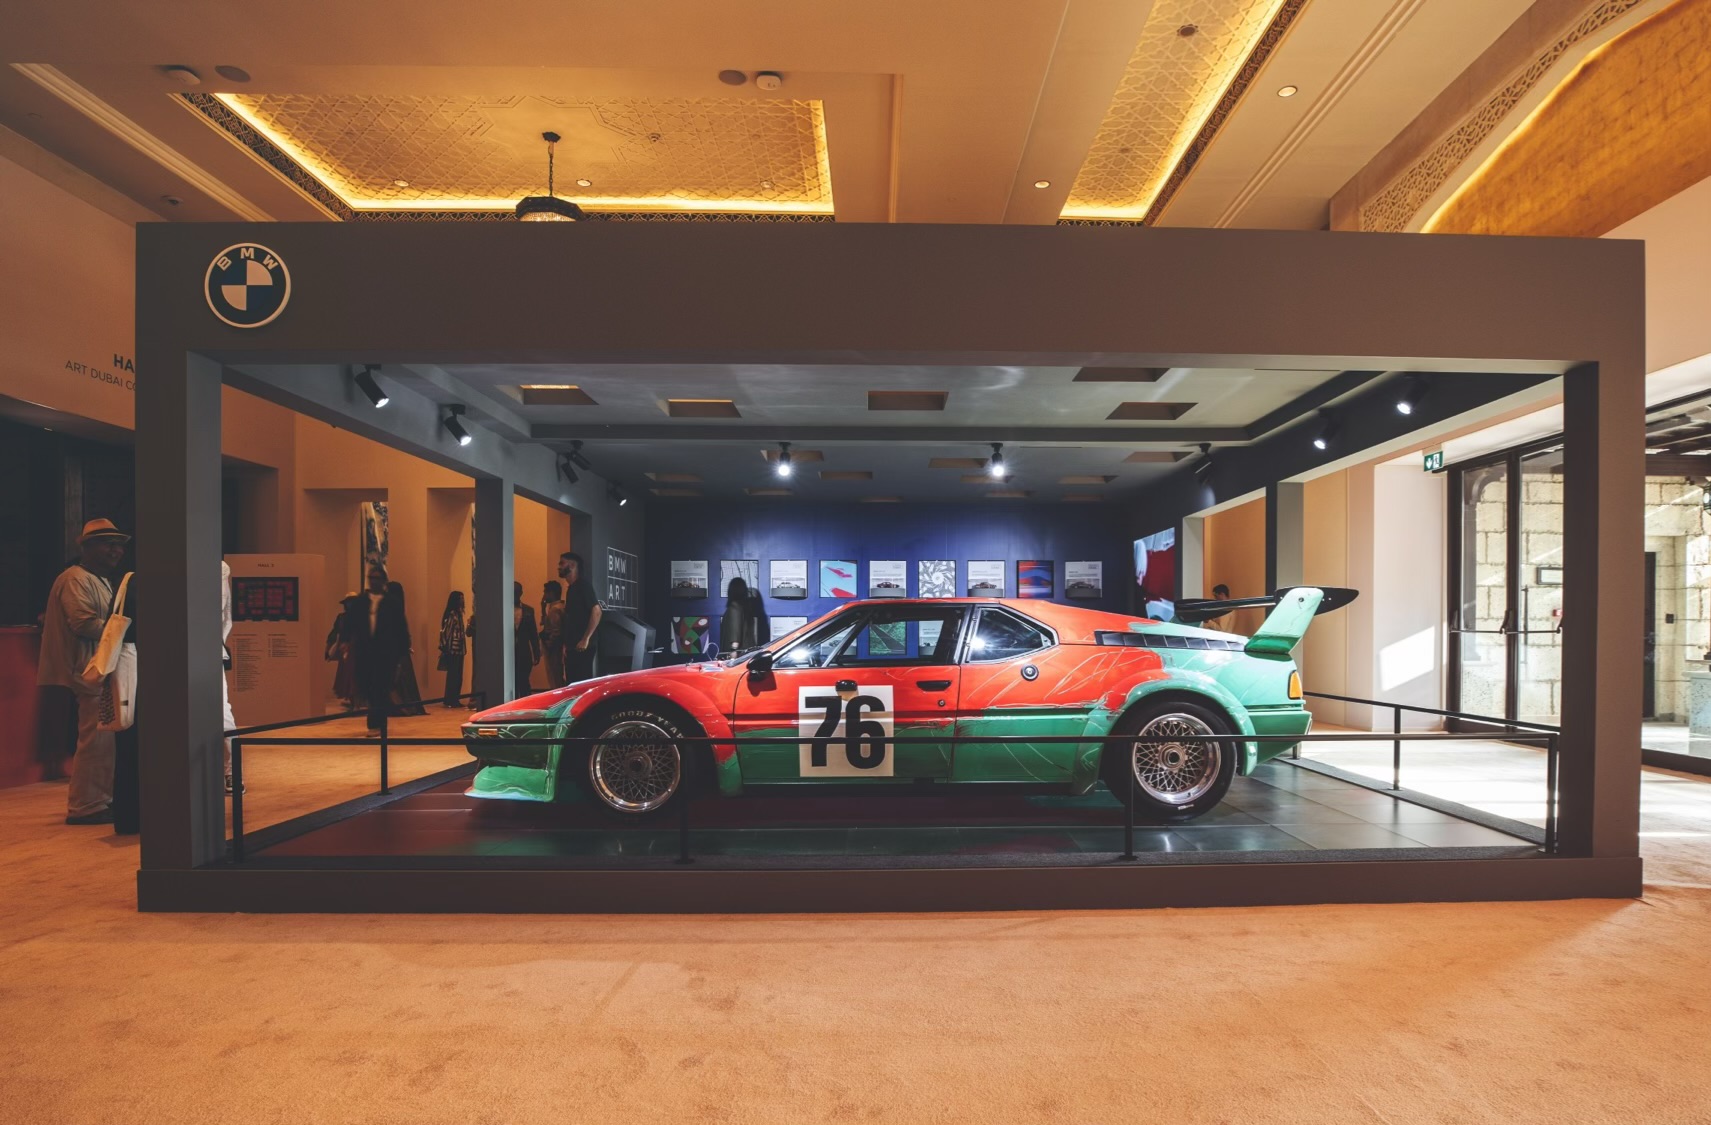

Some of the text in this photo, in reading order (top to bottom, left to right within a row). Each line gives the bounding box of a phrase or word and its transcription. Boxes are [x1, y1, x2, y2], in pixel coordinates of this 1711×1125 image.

[216, 247, 279, 271] BMW
[65, 360, 88, 375] ART
[90, 367, 123, 387] DUBAI
[113, 353, 135, 373] HA
[608, 555, 627, 574] BMW
[608, 583, 626, 601] ART
[804, 695, 886, 769] 76
